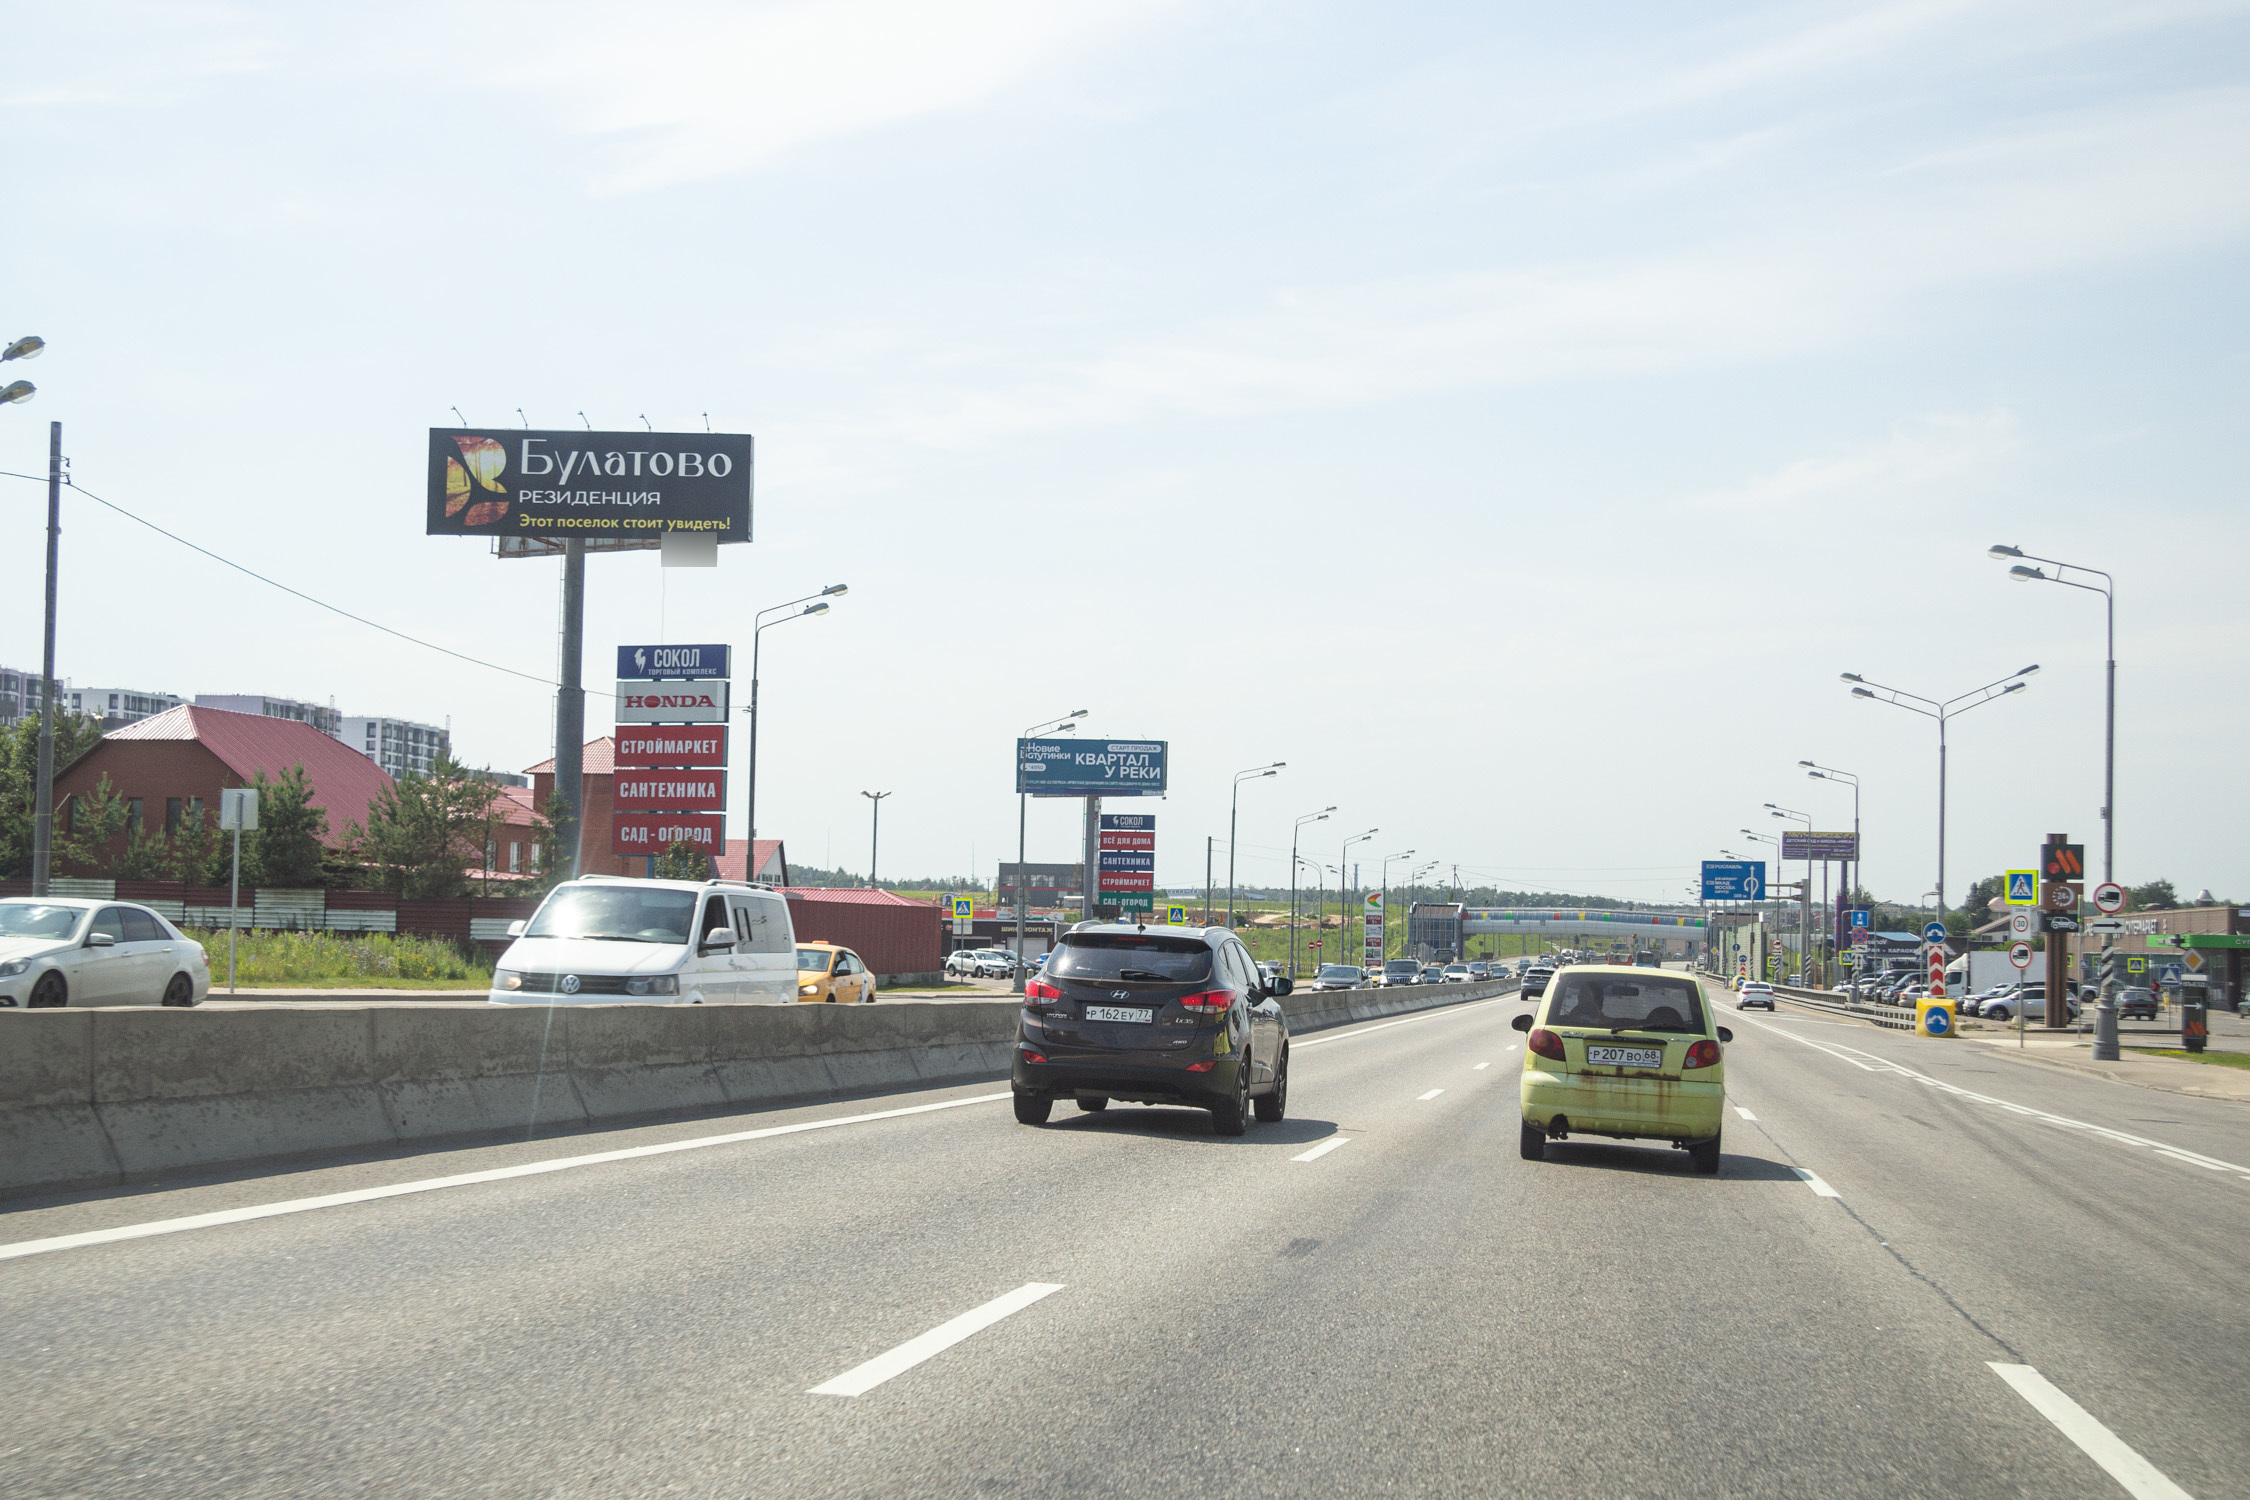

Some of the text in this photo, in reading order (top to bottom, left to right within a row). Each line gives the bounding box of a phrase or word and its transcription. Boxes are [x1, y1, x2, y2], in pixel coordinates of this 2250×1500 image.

[521, 438, 733, 486] Булатово
[519, 490, 661, 507] РЕЗИДЕНЦИЯ
[519, 513, 731, 533] Этот поселок стоит увидеть!
[653, 648, 701, 668] СОКОЛ
[648, 668, 681, 676] ТОРГОВЫЙ
[624, 695, 716, 709] HONDA
[621, 737, 718, 754] СТРОЙМАРКЕТ
[1075, 752, 1149, 767] КВАРТАЛ
[1104, 766, 1161, 780] У РЕКИ
[619, 782, 716, 798] САНТЕХНИКА
[1120, 816, 1143, 826] СОКОЛ
[620, 826, 649, 844] САД
[658, 826, 712, 845] ОГОРОД
[1103, 836, 1151, 846] ВСЁ ДЛЯ ДОМА
[1102, 857, 1151, 866] САНТЕХНИКА
[1102, 877, 1150, 887] СТРОЙМАРКЕТ
[1103, 897, 1117, 906] САД
[1121, 898, 1148, 907] ОГОРОД
[1001, 925, 1054, 934] ШИНОНТАЖ
[2016, 920, 2026, 928] 30
